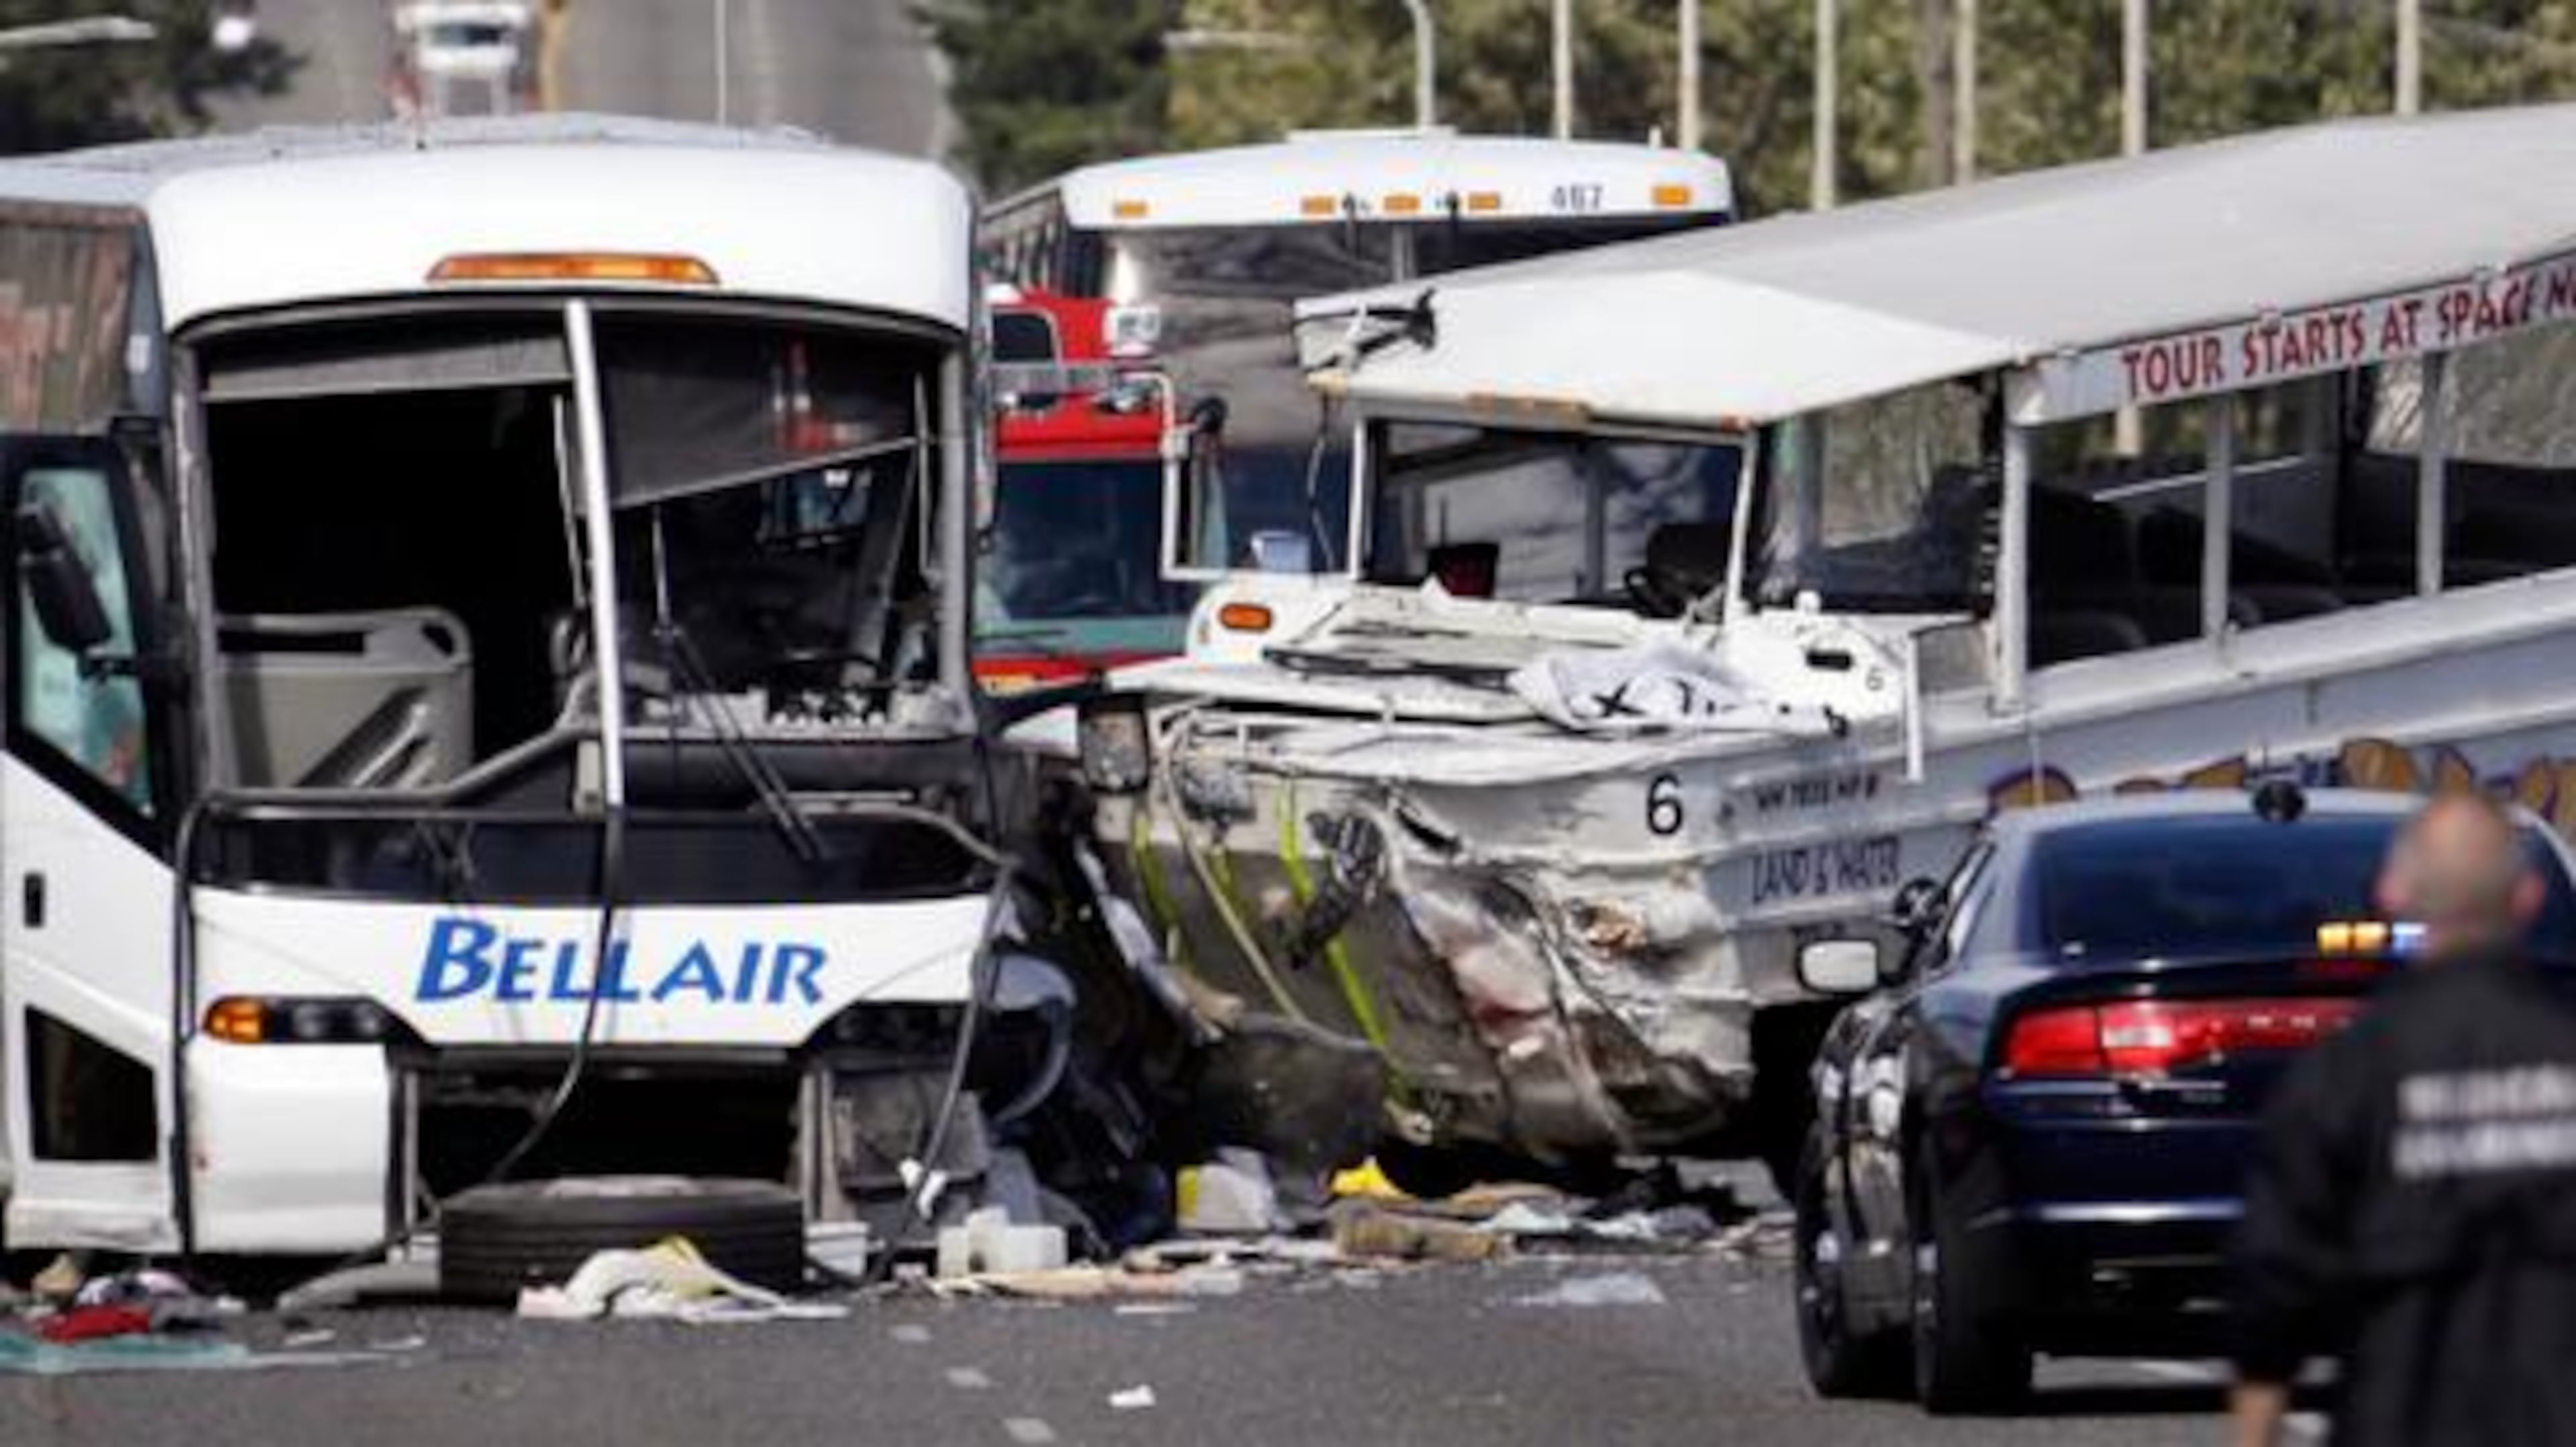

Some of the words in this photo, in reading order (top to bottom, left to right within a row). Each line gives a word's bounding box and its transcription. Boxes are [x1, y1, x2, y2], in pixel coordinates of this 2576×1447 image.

[2123, 334, 2223, 398] TOUR
[2243, 311, 2362, 377] STARTS
[2379, 299, 2420, 352] AT
[1646, 771, 1683, 835] 6
[1752, 848, 1809, 904] LAND
